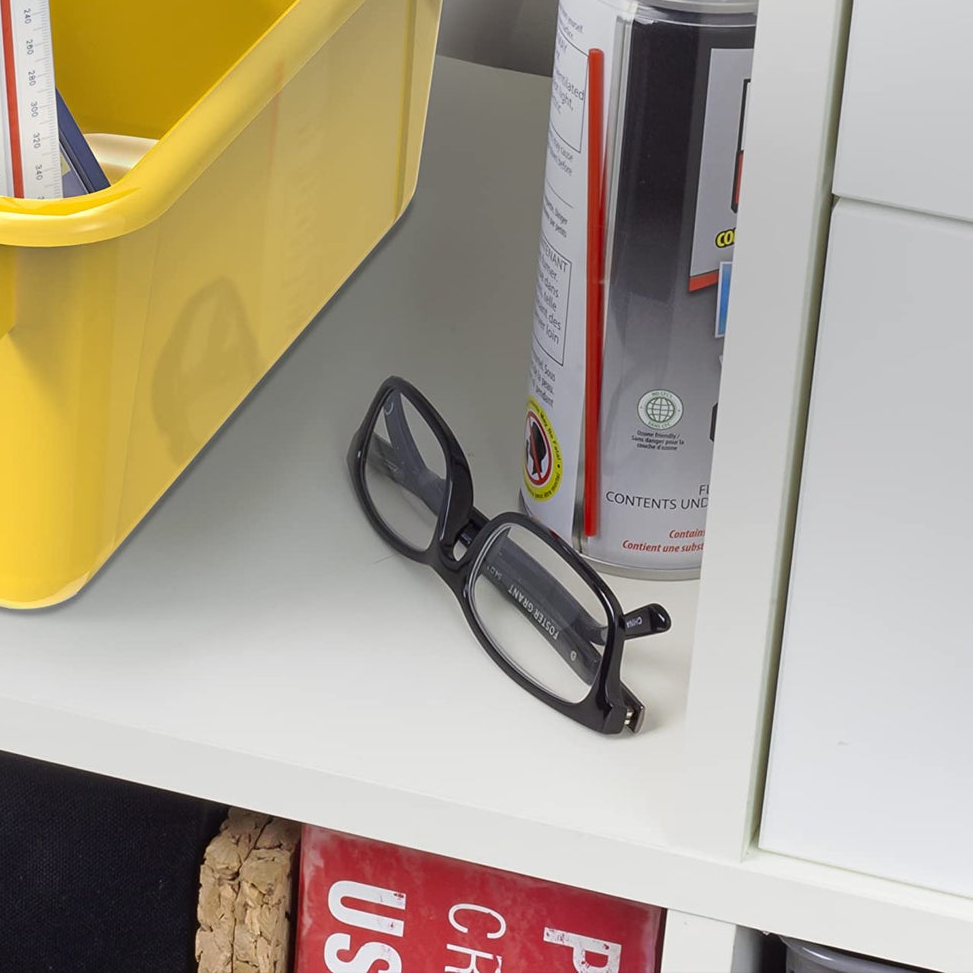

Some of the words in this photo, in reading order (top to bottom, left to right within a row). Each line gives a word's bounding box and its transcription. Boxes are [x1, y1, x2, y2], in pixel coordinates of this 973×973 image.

[26, 39, 34, 55] 260
[28, 70, 36, 86] 280
[33, 133, 41, 149] 320
[35, 164, 43, 181] 340
[715, 229, 736, 248] CO
[548, 314, 561, 330] des
[546, 324, 559, 344] loin
[605, 490, 677, 510] CONTENTS
[622, 540, 661, 552] Contient
[507, 584, 534, 613] GRANT
[533, 610, 560, 640] FOSTER
